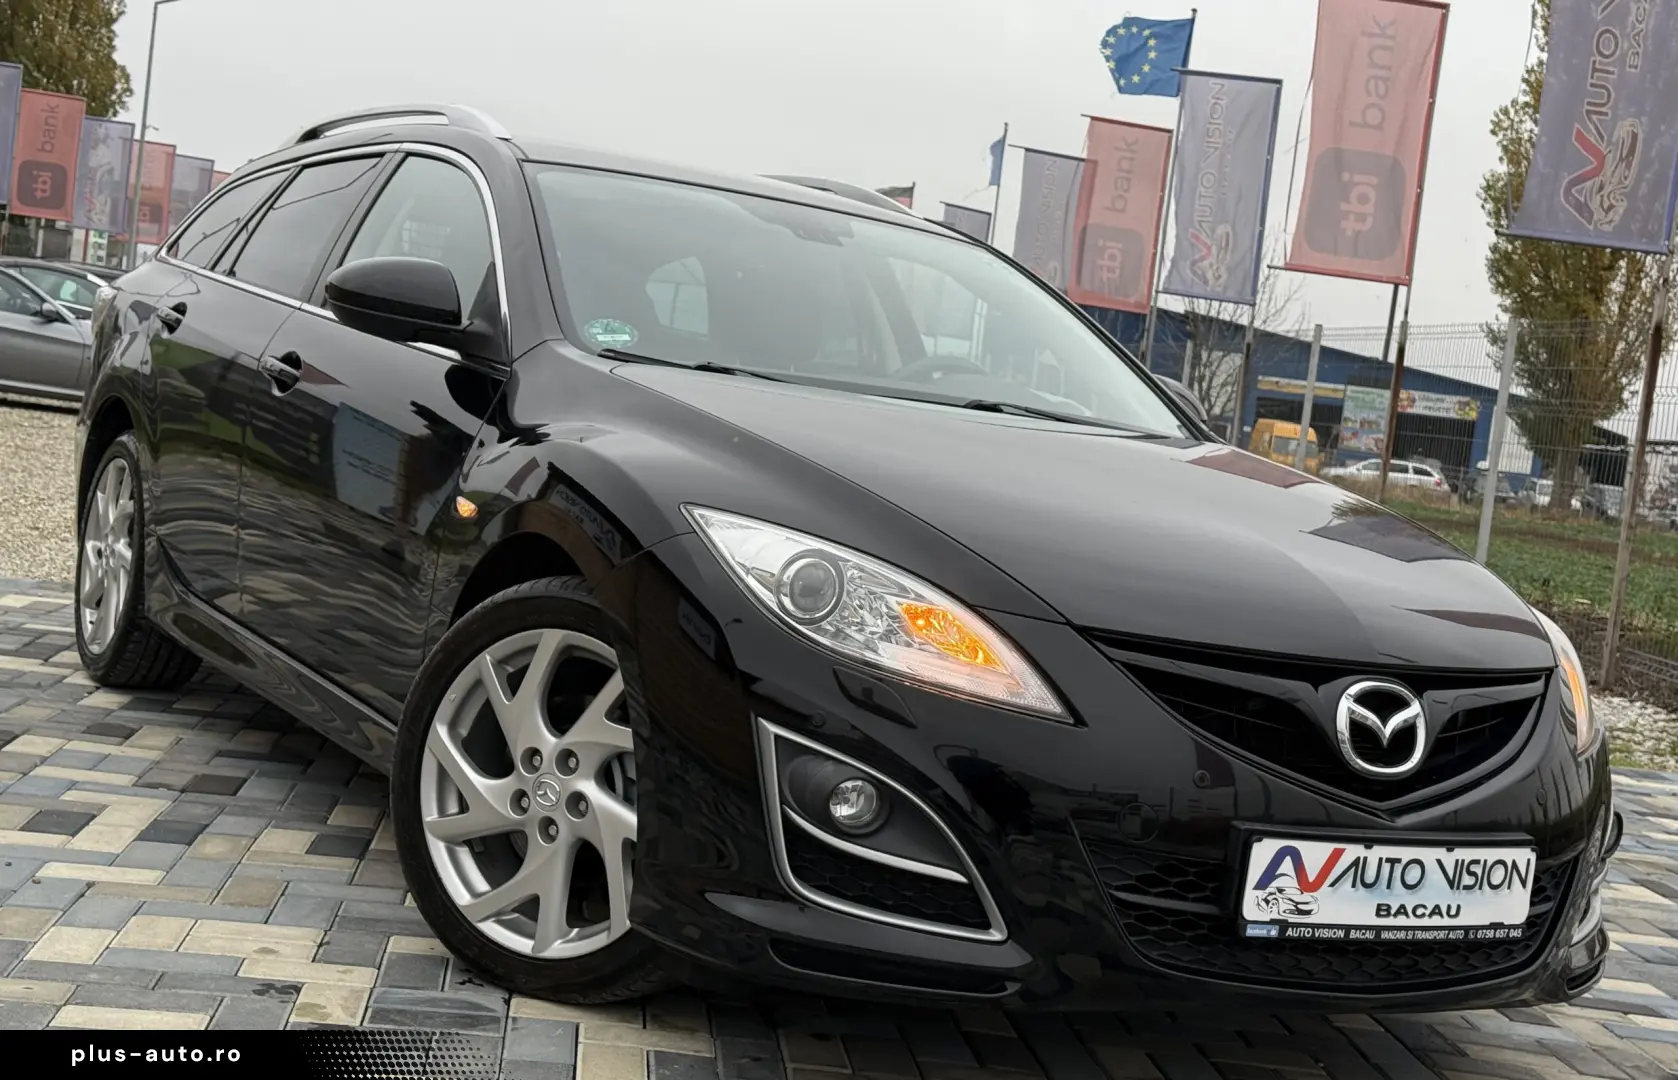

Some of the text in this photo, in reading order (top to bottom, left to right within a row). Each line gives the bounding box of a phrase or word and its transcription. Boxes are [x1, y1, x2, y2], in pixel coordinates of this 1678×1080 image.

[33, 102, 60, 200] tbi bank
[1340, 14, 1397, 236] tbi bank
[1097, 135, 1139, 282] tbi bank
[1327, 855, 1426, 891] AUTO
[1435, 857, 1531, 891] VISION
[1286, 927, 1312, 938] AUTO
[1314, 928, 1345, 939] VISION
[1350, 929, 1375, 939] BACAU
[1381, 930, 1407, 940] VANZARI
[1406, 930, 1415, 940] SI
[1414, 930, 1449, 940] TRANSPORT
[1448, 930, 1465, 939] AUTO
[1477, 928, 1495, 939] 0758
[1495, 928, 1509, 938] 657
[1509, 928, 1523, 938] 045
[1375, 903, 1462, 919] BACAU
